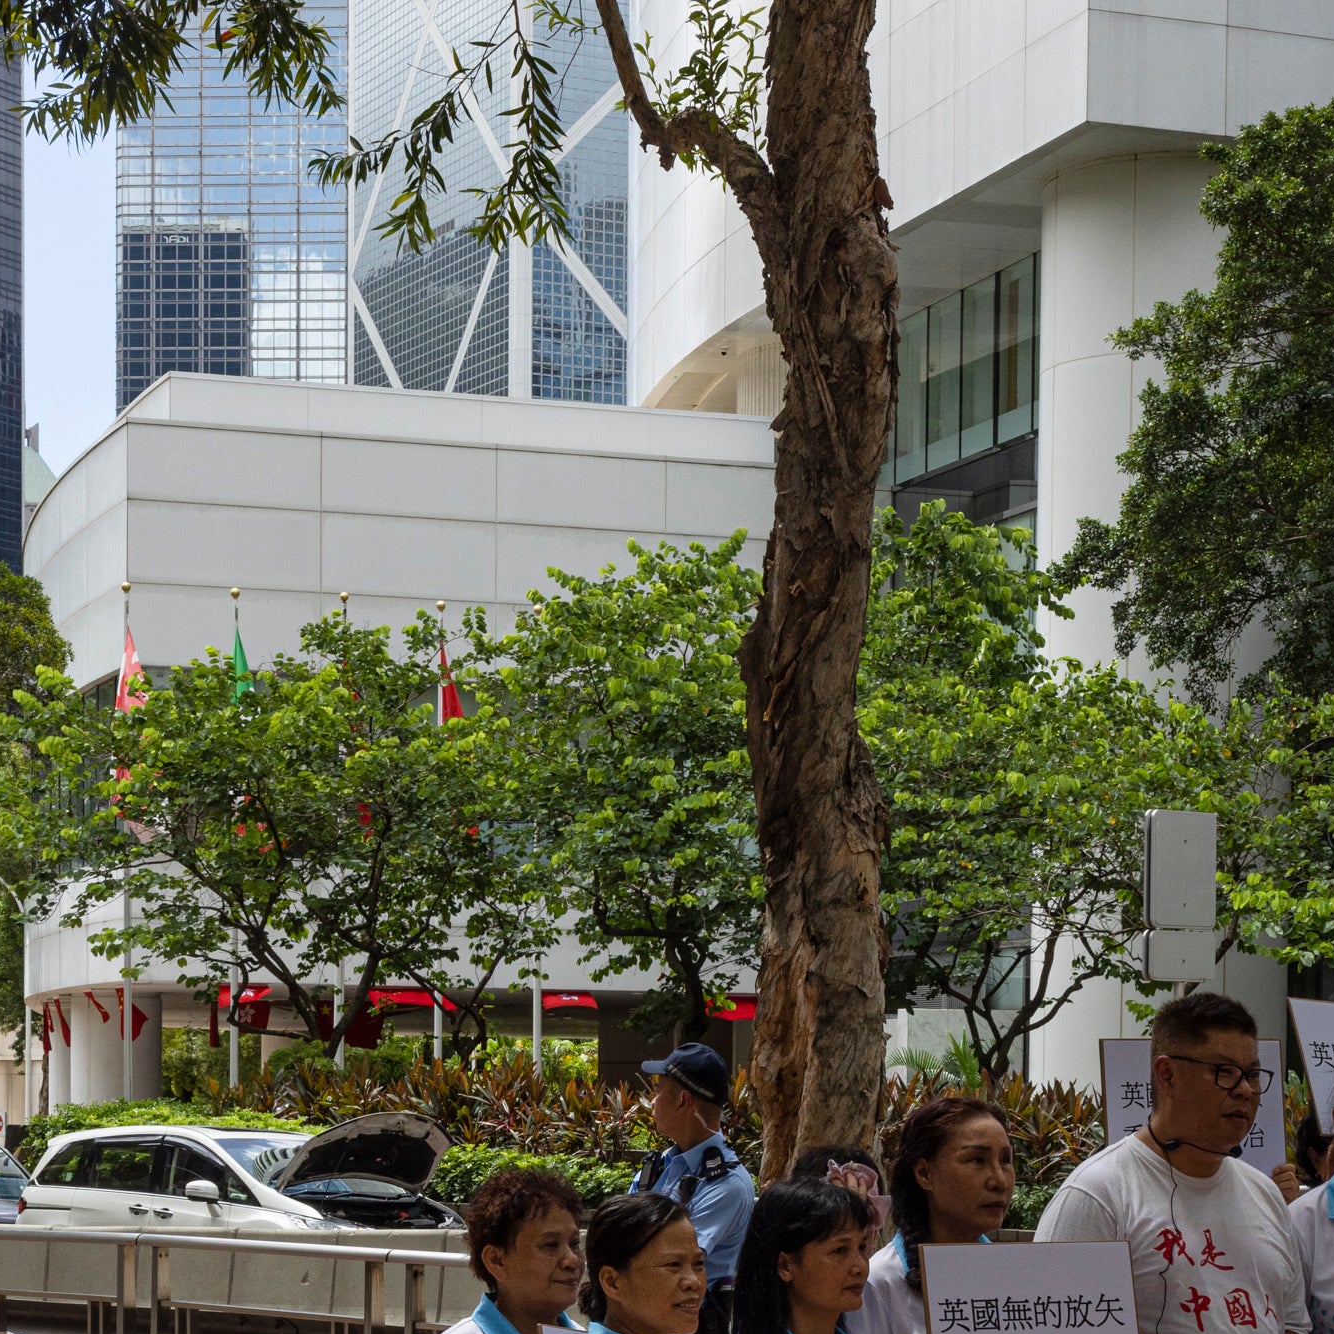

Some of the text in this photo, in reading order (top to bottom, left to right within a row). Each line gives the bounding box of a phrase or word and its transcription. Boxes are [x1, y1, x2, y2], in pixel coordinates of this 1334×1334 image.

[1154, 1228, 1235, 1271] 我是
[938, 1293, 1125, 1333] 英國無的放矢
[1179, 1286, 1278, 1332] 中國人
